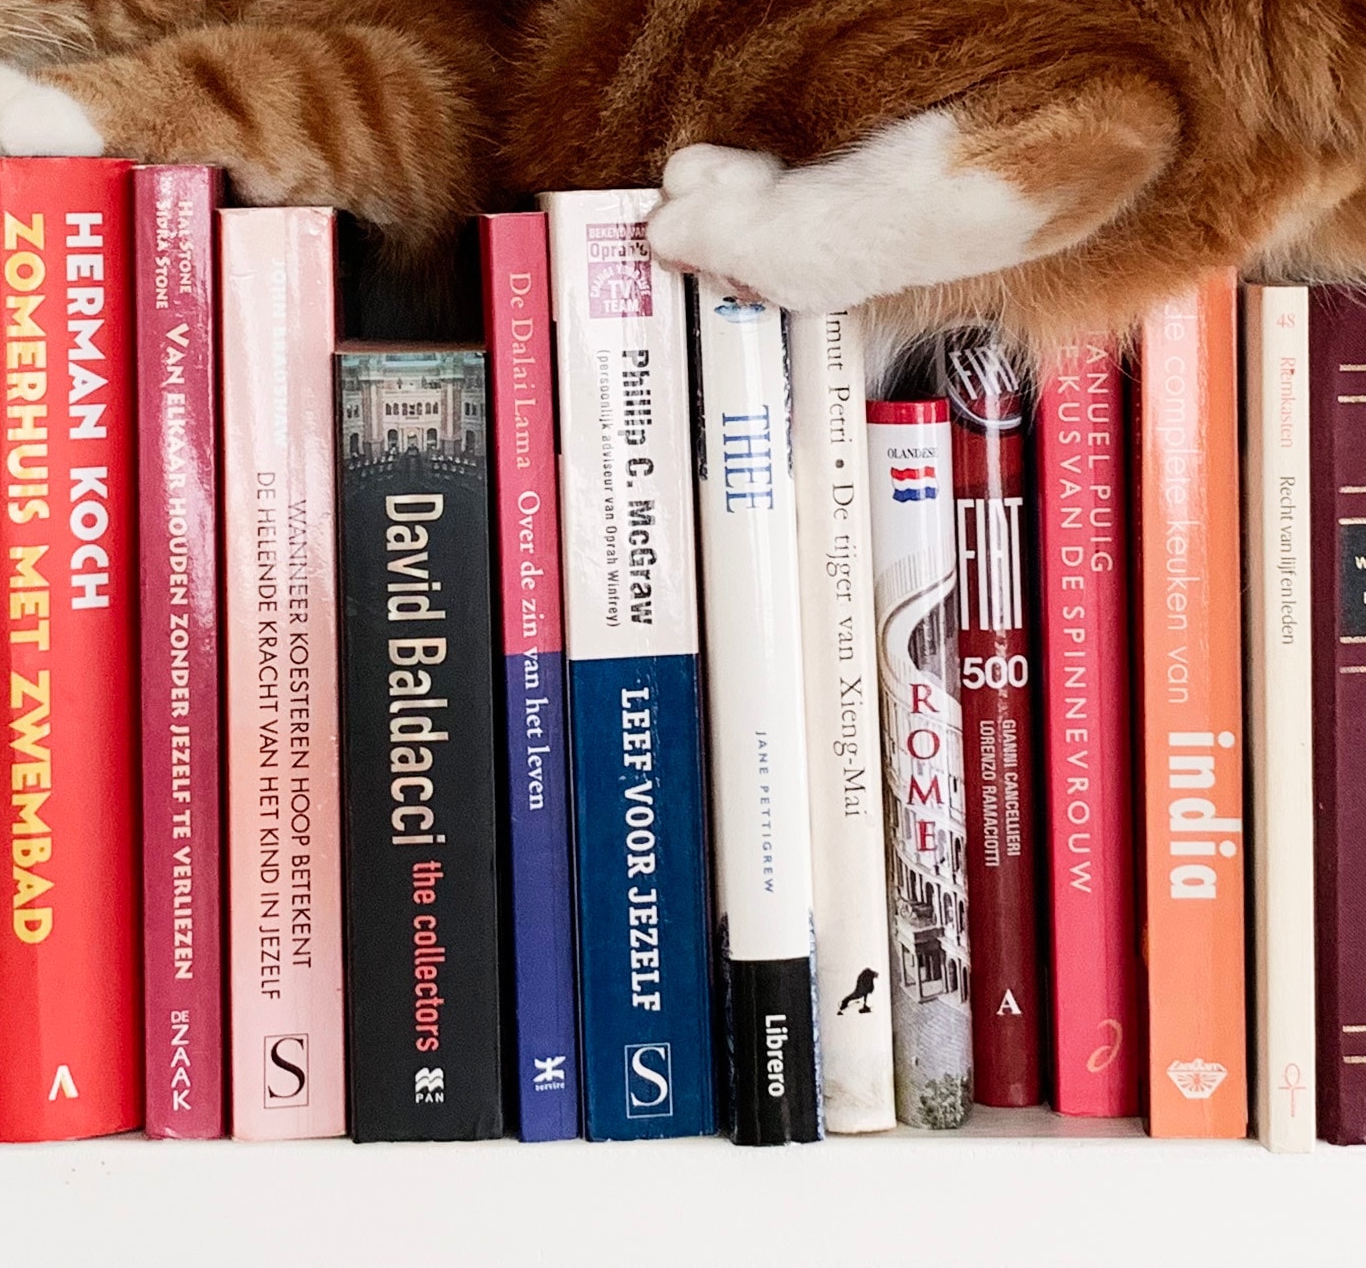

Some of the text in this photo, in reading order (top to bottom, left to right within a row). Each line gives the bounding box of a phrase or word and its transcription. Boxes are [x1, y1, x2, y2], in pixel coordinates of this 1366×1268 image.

[65, 212, 110, 610] HERMAN KOCH
[722, 404, 774, 513] THEE
[3, 211, 54, 945] ZOMERHUIS MET ZWEMBAD
[956, 497, 1023, 631] FIAT
[525, 697, 550, 811] het leven
[962, 655, 1028, 690] 500
[1063, 605, 1092, 893] SPINNEVROUW
[170, 725, 192, 980] JEZELF TE VERLIEZEN
[385, 494, 449, 1052] David Baldacci the collectors
[621, 686, 661, 1011] LEEF VOOR JEZELF
[755, 731, 774, 894] JANE PETTIGREW
[1167, 731, 1242, 899] india
[170, 1024, 192, 1110] ZAAK
[415, 1092, 444, 1103] PAN
[764, 1014, 787, 1098] Librero
